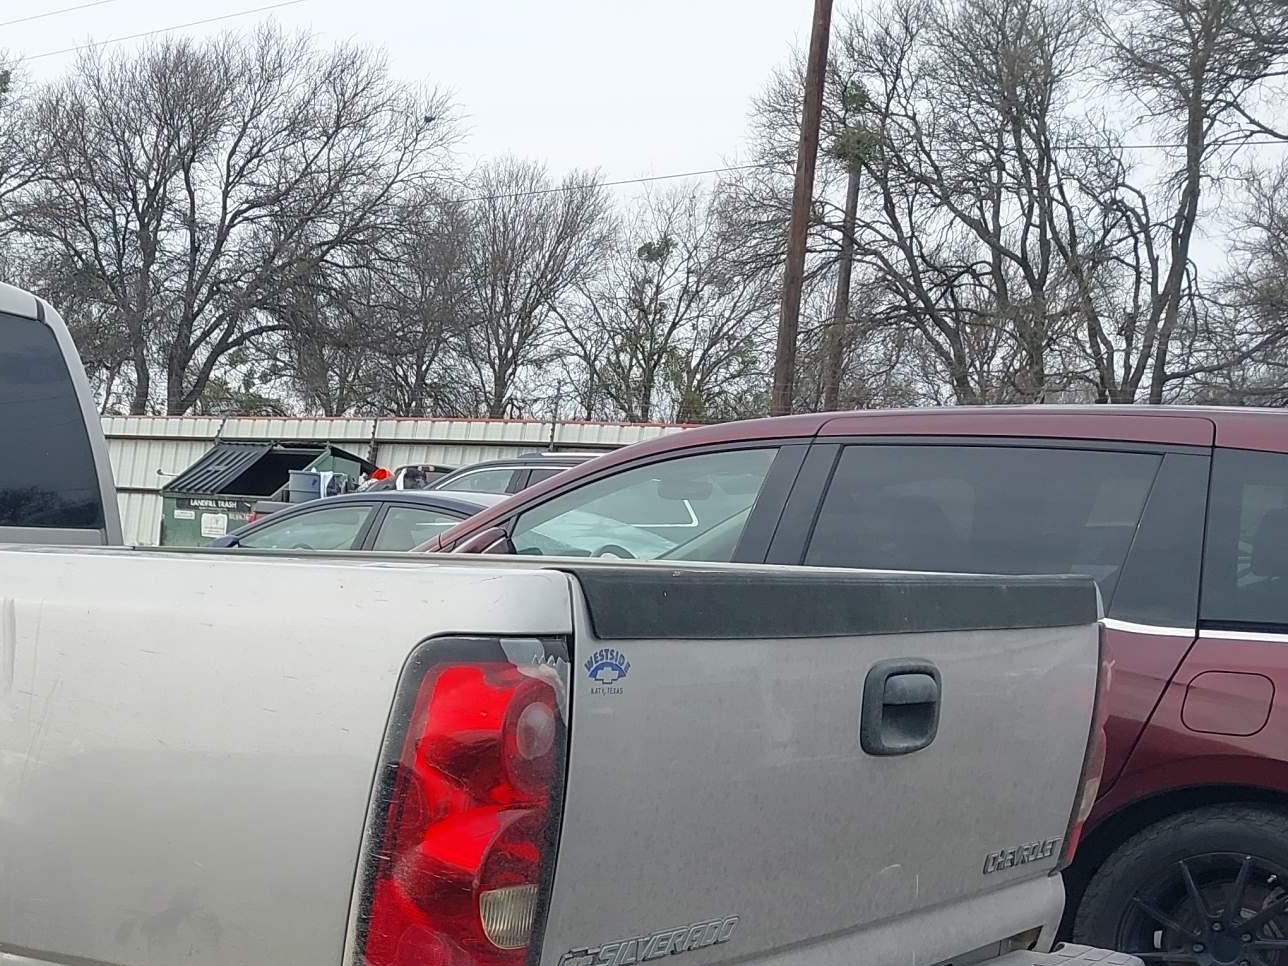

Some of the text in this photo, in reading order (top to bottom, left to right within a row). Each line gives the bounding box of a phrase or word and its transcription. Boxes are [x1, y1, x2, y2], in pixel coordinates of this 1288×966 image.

[190, 499, 237, 508] LANDFILL TRASH
[584, 648, 631, 673] WESTSIDE
[607, 687, 624, 695] TEXAS
[982, 837, 1064, 875] CHEVROLET
